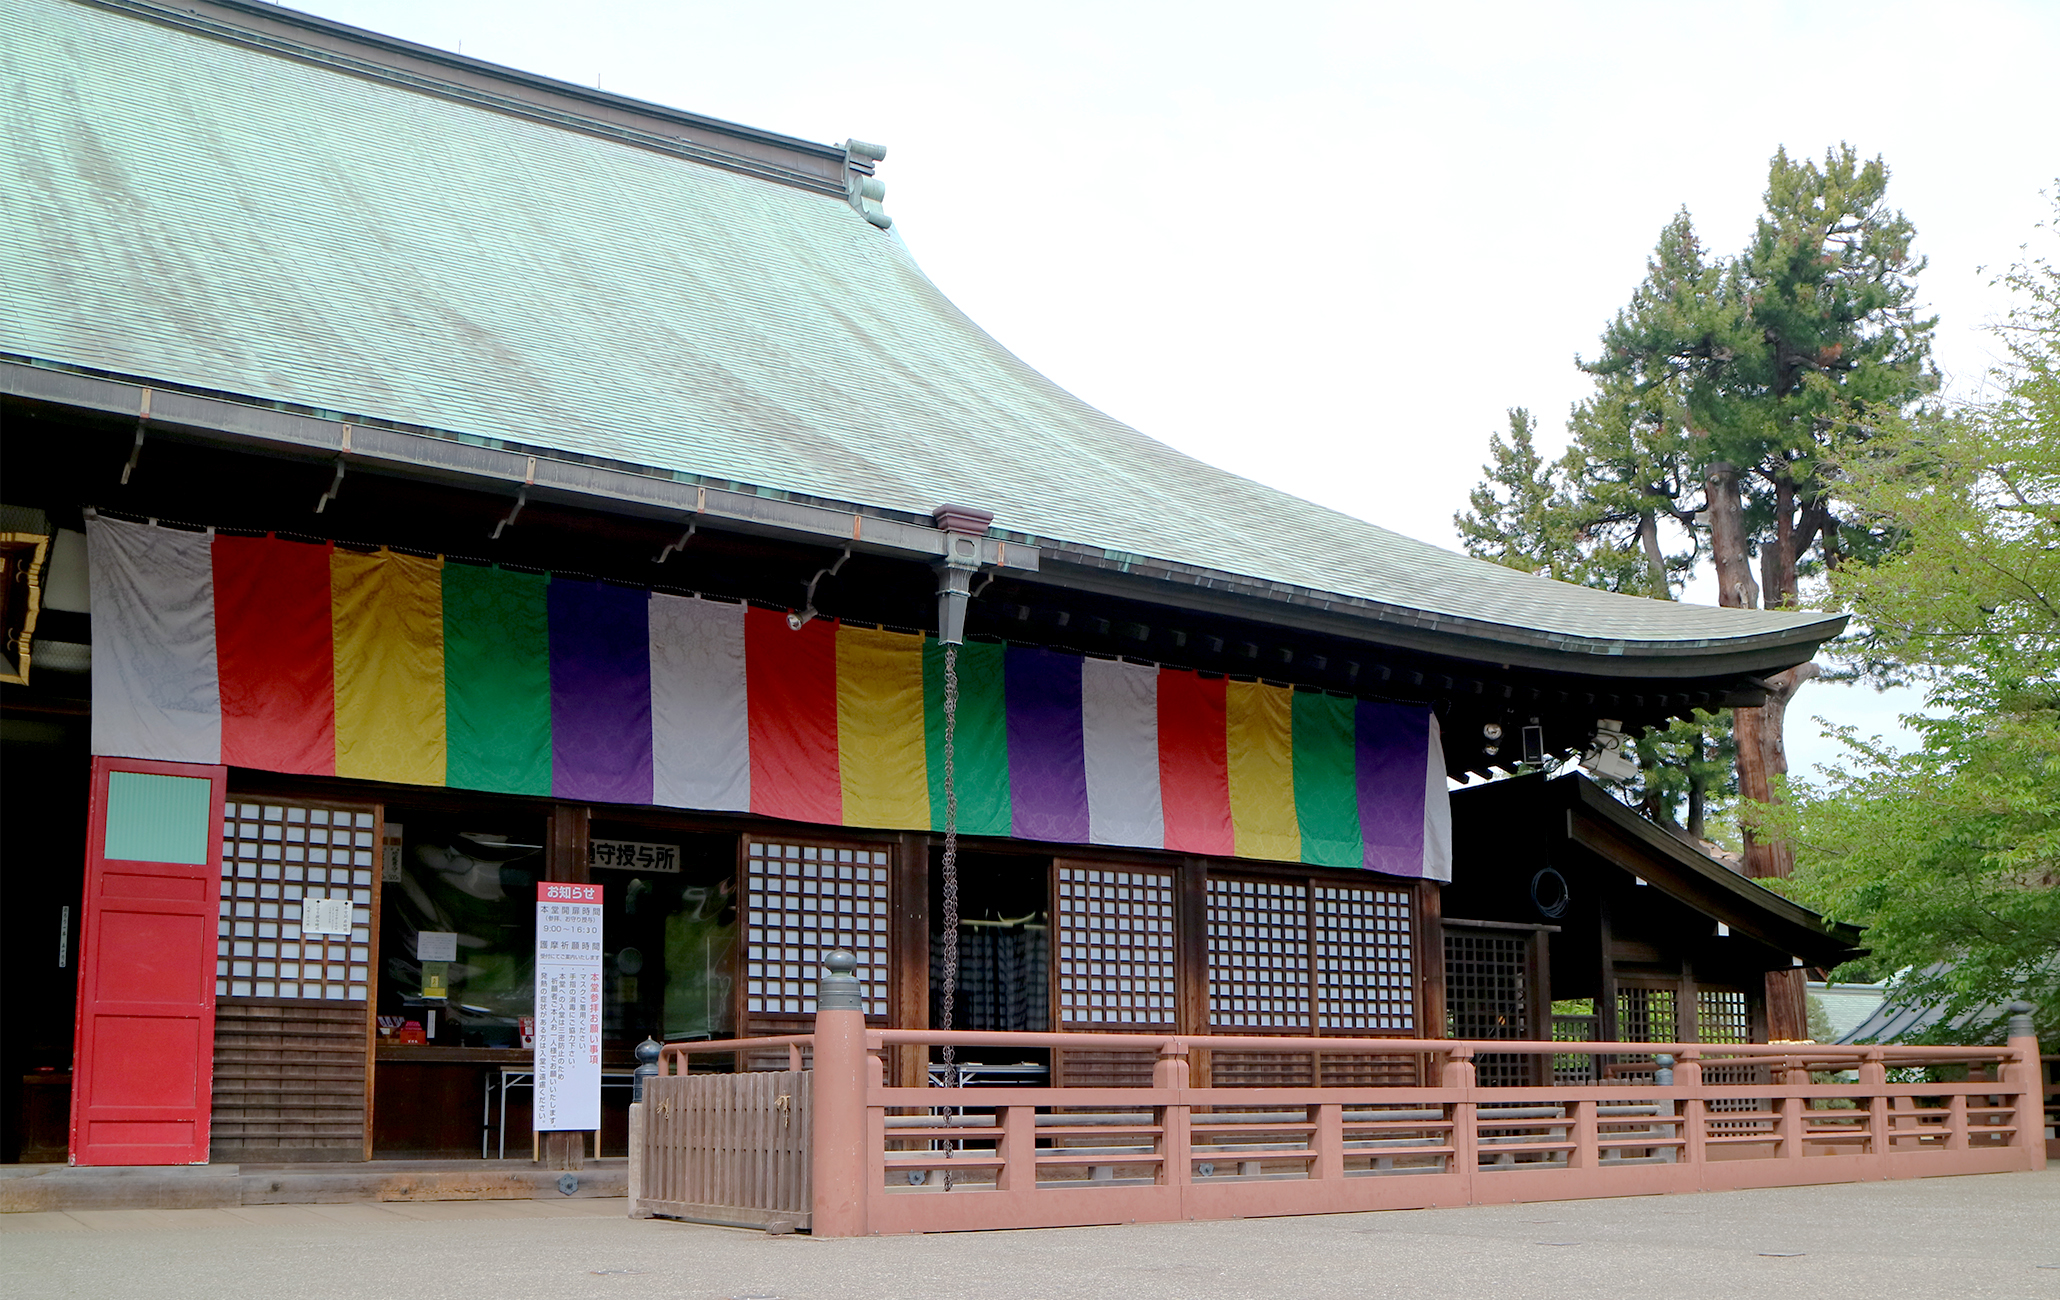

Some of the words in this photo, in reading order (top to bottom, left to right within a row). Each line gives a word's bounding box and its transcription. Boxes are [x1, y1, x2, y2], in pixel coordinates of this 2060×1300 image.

[546, 885, 596, 900] お知らせ
[540, 905, 601, 916] 本堂開扉時間
[540, 940, 601, 951] 護摩祈願時間
[589, 972, 600, 1065] 本堂参拝お願い事項
